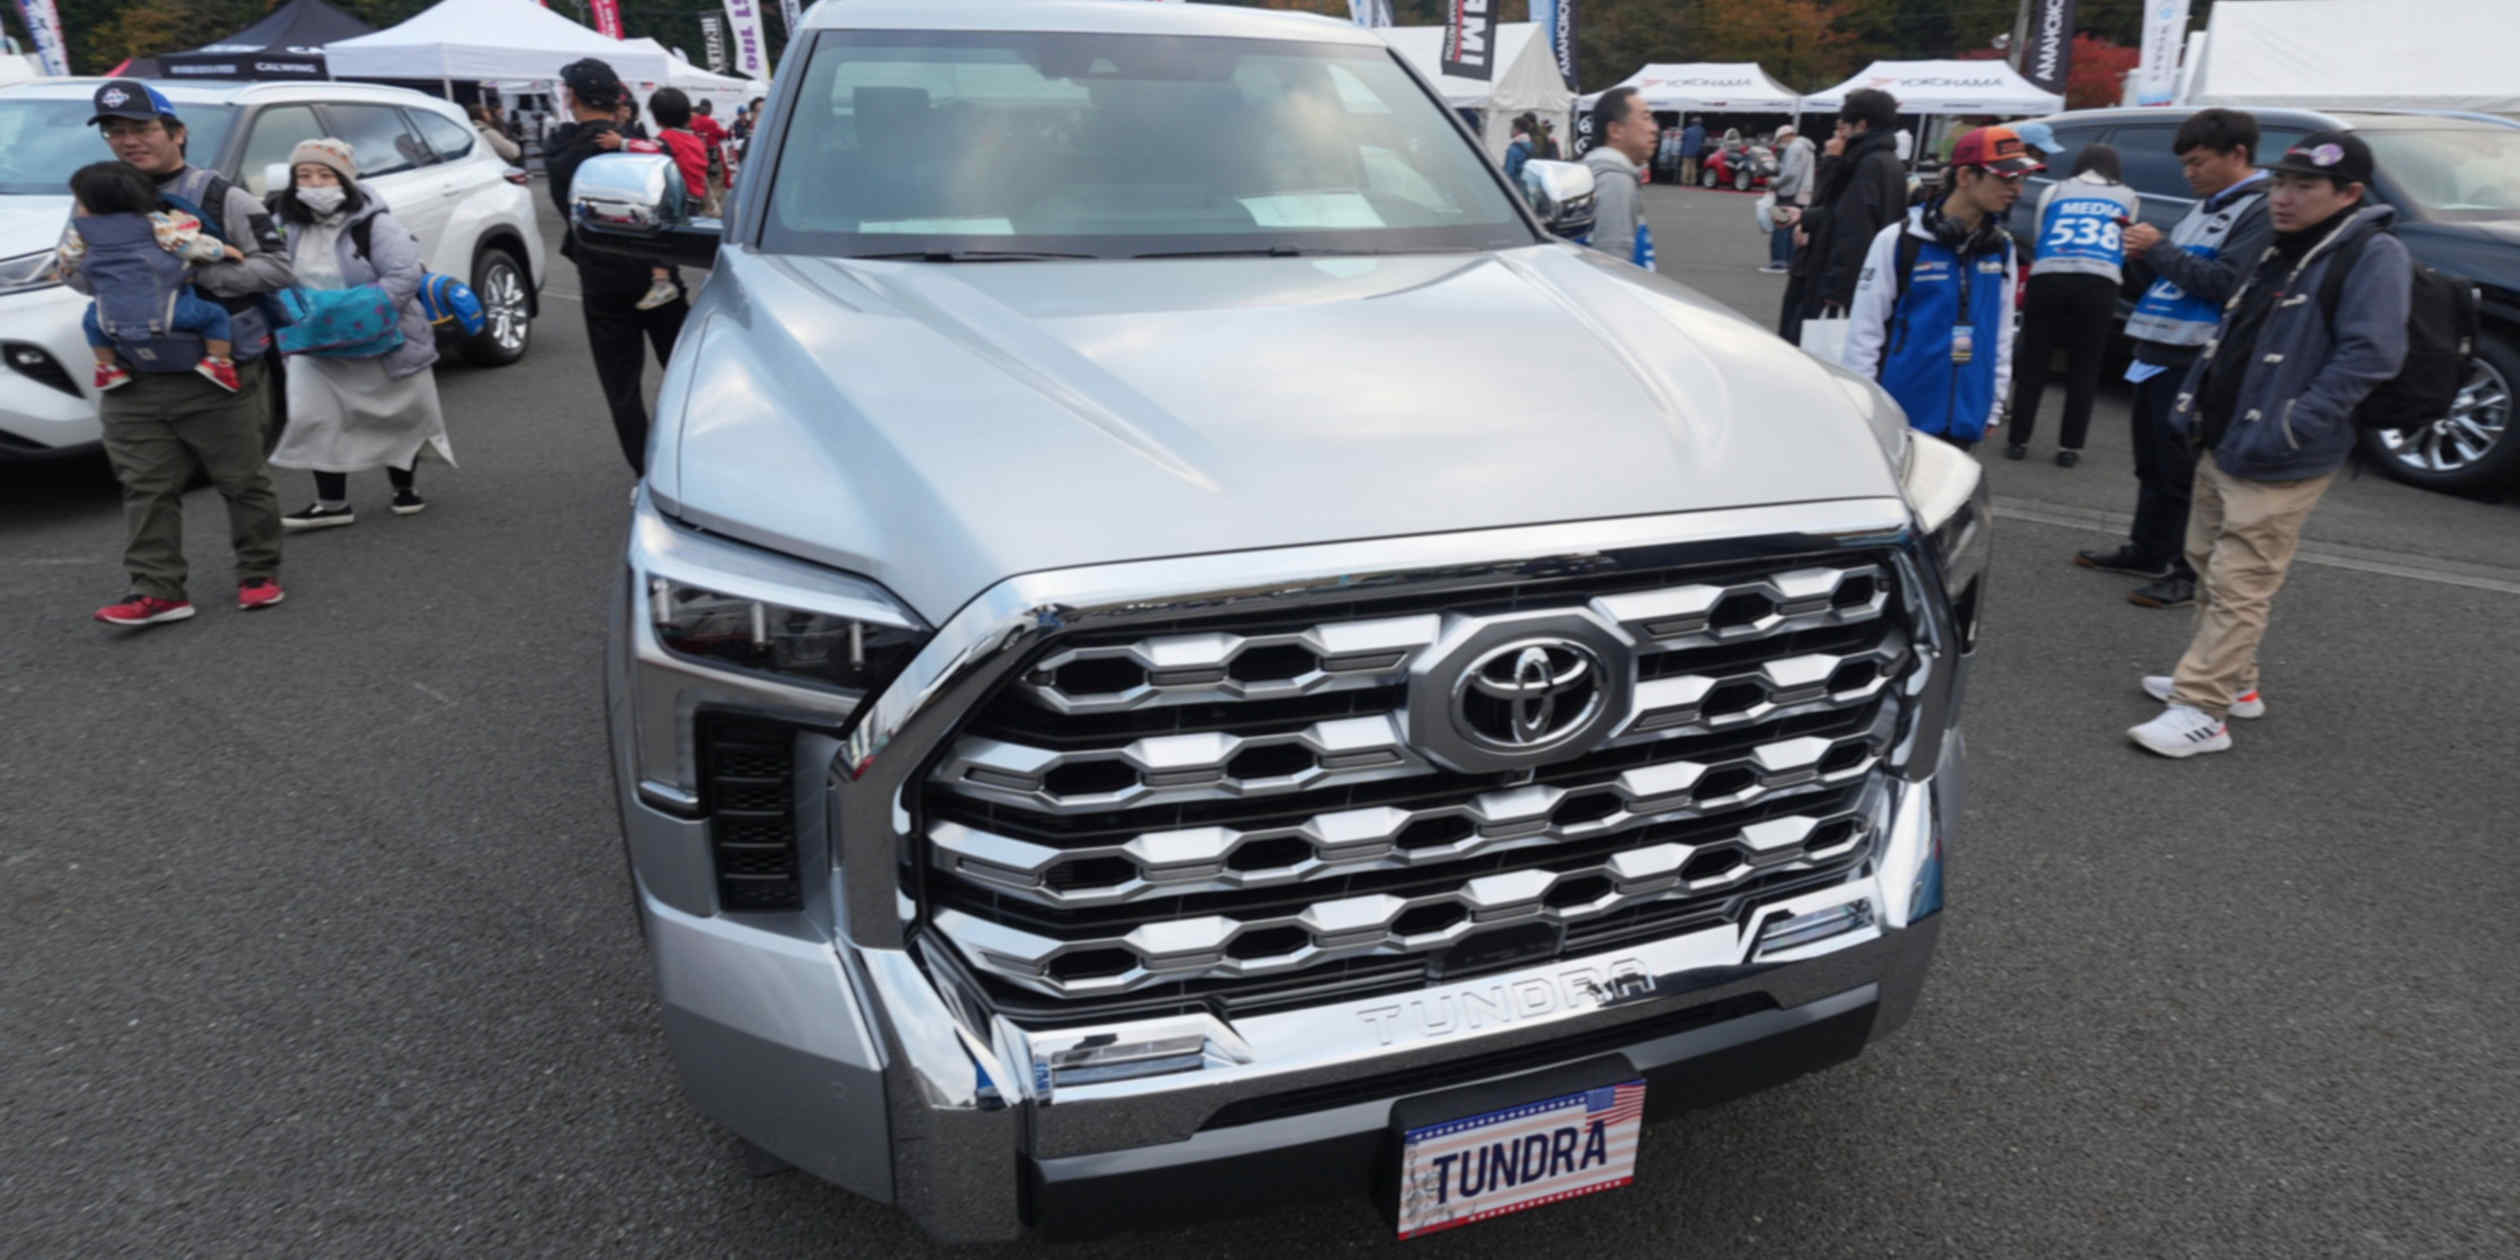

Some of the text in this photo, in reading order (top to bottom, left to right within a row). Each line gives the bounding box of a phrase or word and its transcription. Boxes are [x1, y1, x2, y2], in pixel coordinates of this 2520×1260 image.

[1665, 78, 1752, 87] YOKOHAMA
[1900, 77, 2003, 88] YOKOHAMA
[2046, 217, 2120, 251] 538
[1357, 957, 1656, 1046] TUNDRA
[1432, 1119, 1608, 1205] TUNDRA
